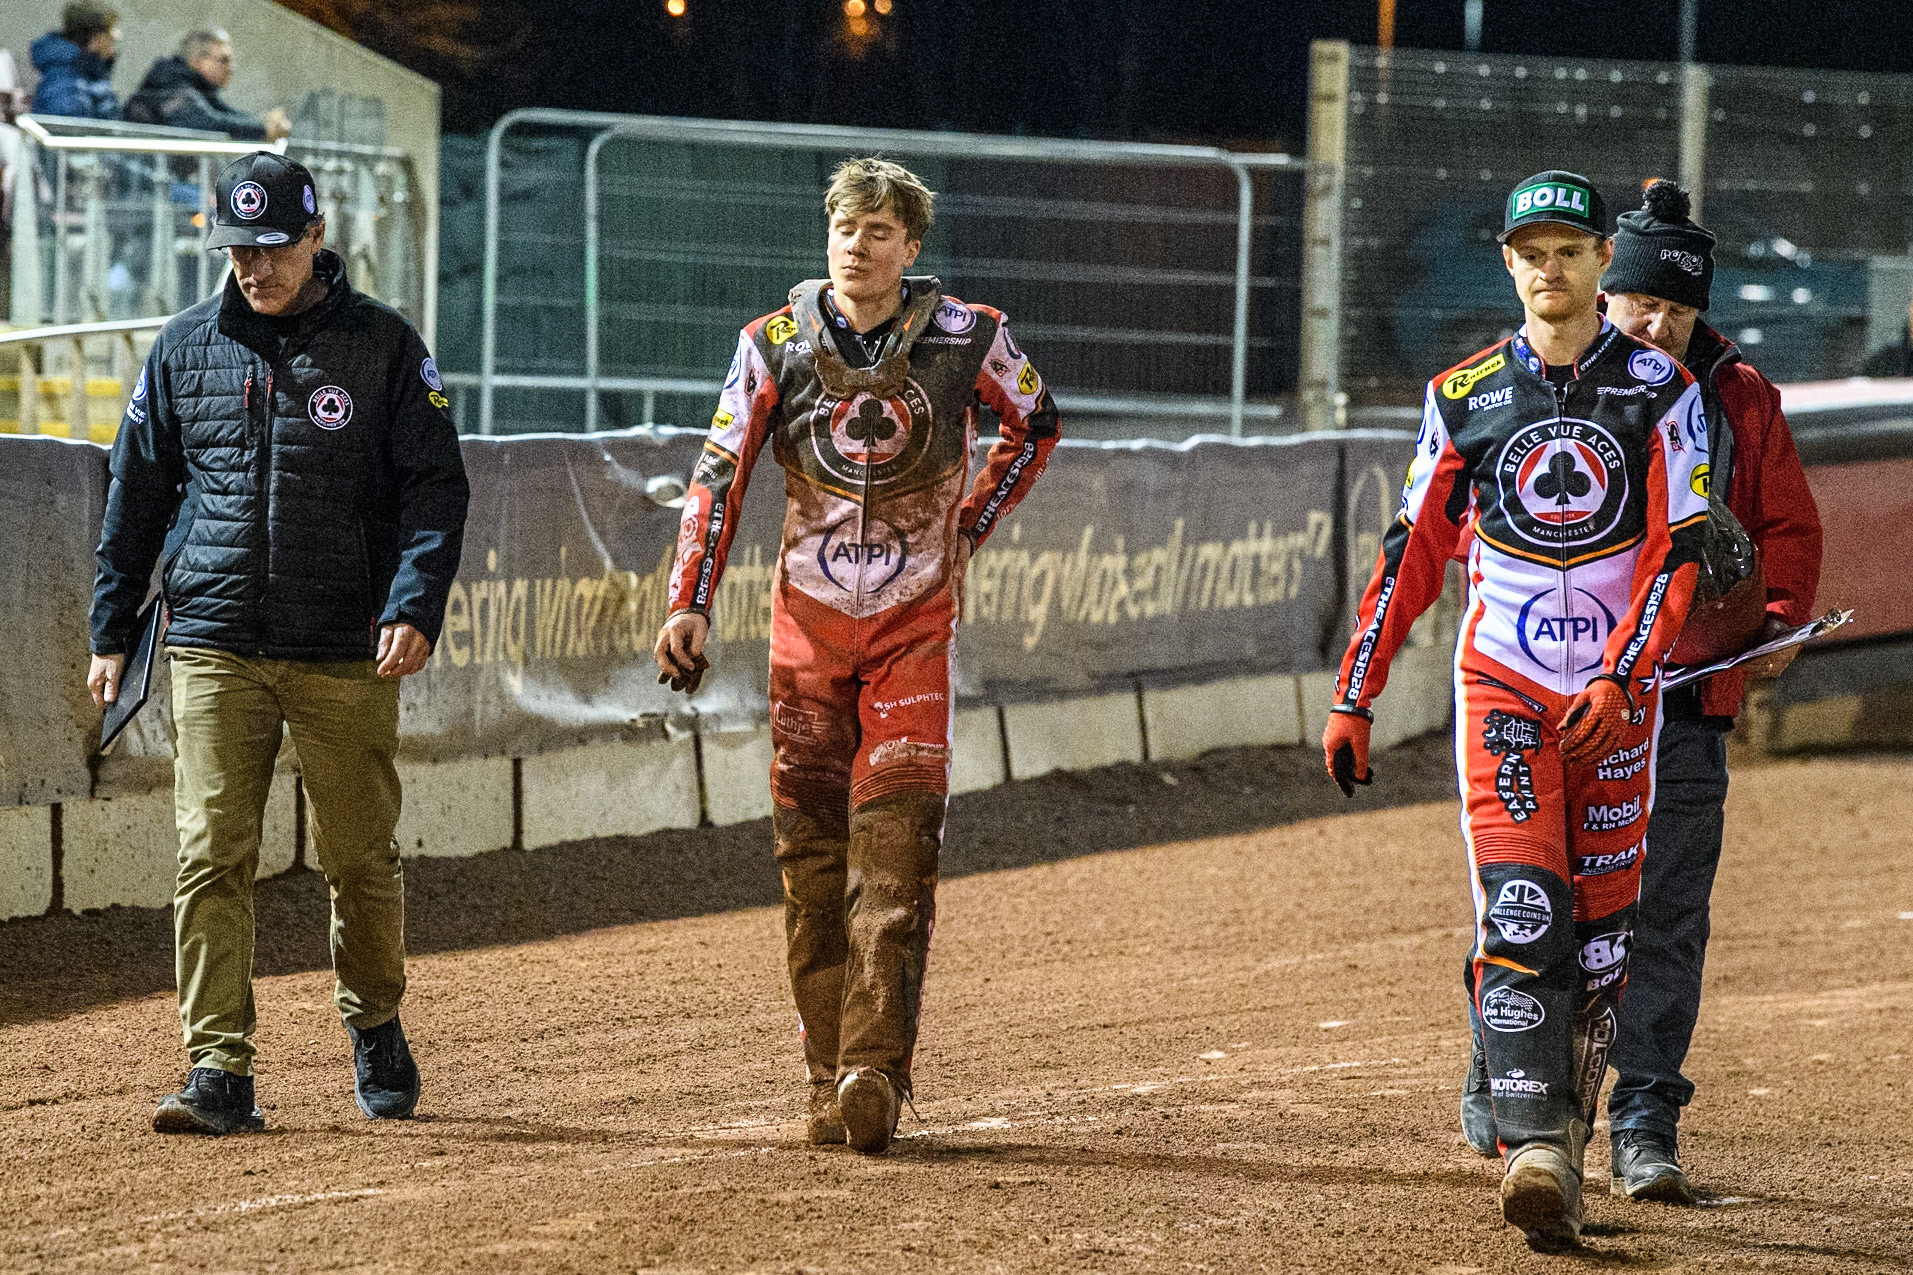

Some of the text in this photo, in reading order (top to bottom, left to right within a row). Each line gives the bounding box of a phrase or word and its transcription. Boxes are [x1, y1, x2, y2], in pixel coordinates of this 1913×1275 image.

[1516, 187, 1585, 213] BOLL
[941, 305, 966, 322] ATPI
[786, 340, 812, 352] RO
[1636, 358, 1665, 376] ATPI
[904, 389, 925, 415] CES
[1467, 386, 1514, 411] ROWE
[1503, 424, 1621, 473] BELLE VUE ACES
[831, 541, 892, 566] ATPI
[1533, 616, 1598, 643] ATPI
[1616, 573, 1670, 676] @THEACES1928
[883, 701, 897, 711] SH
[1598, 736, 1650, 767] ichard
[1597, 757, 1647, 780] Hayes
[1588, 794, 1640, 822] Mobil
[1581, 842, 1640, 867] TRAK
[1522, 910, 1541, 920] COINS
[1485, 1005, 1539, 1021] Joe Hughes
[1490, 1017, 1529, 1026] International
[1489, 1077, 1549, 1095] MOTOREX
